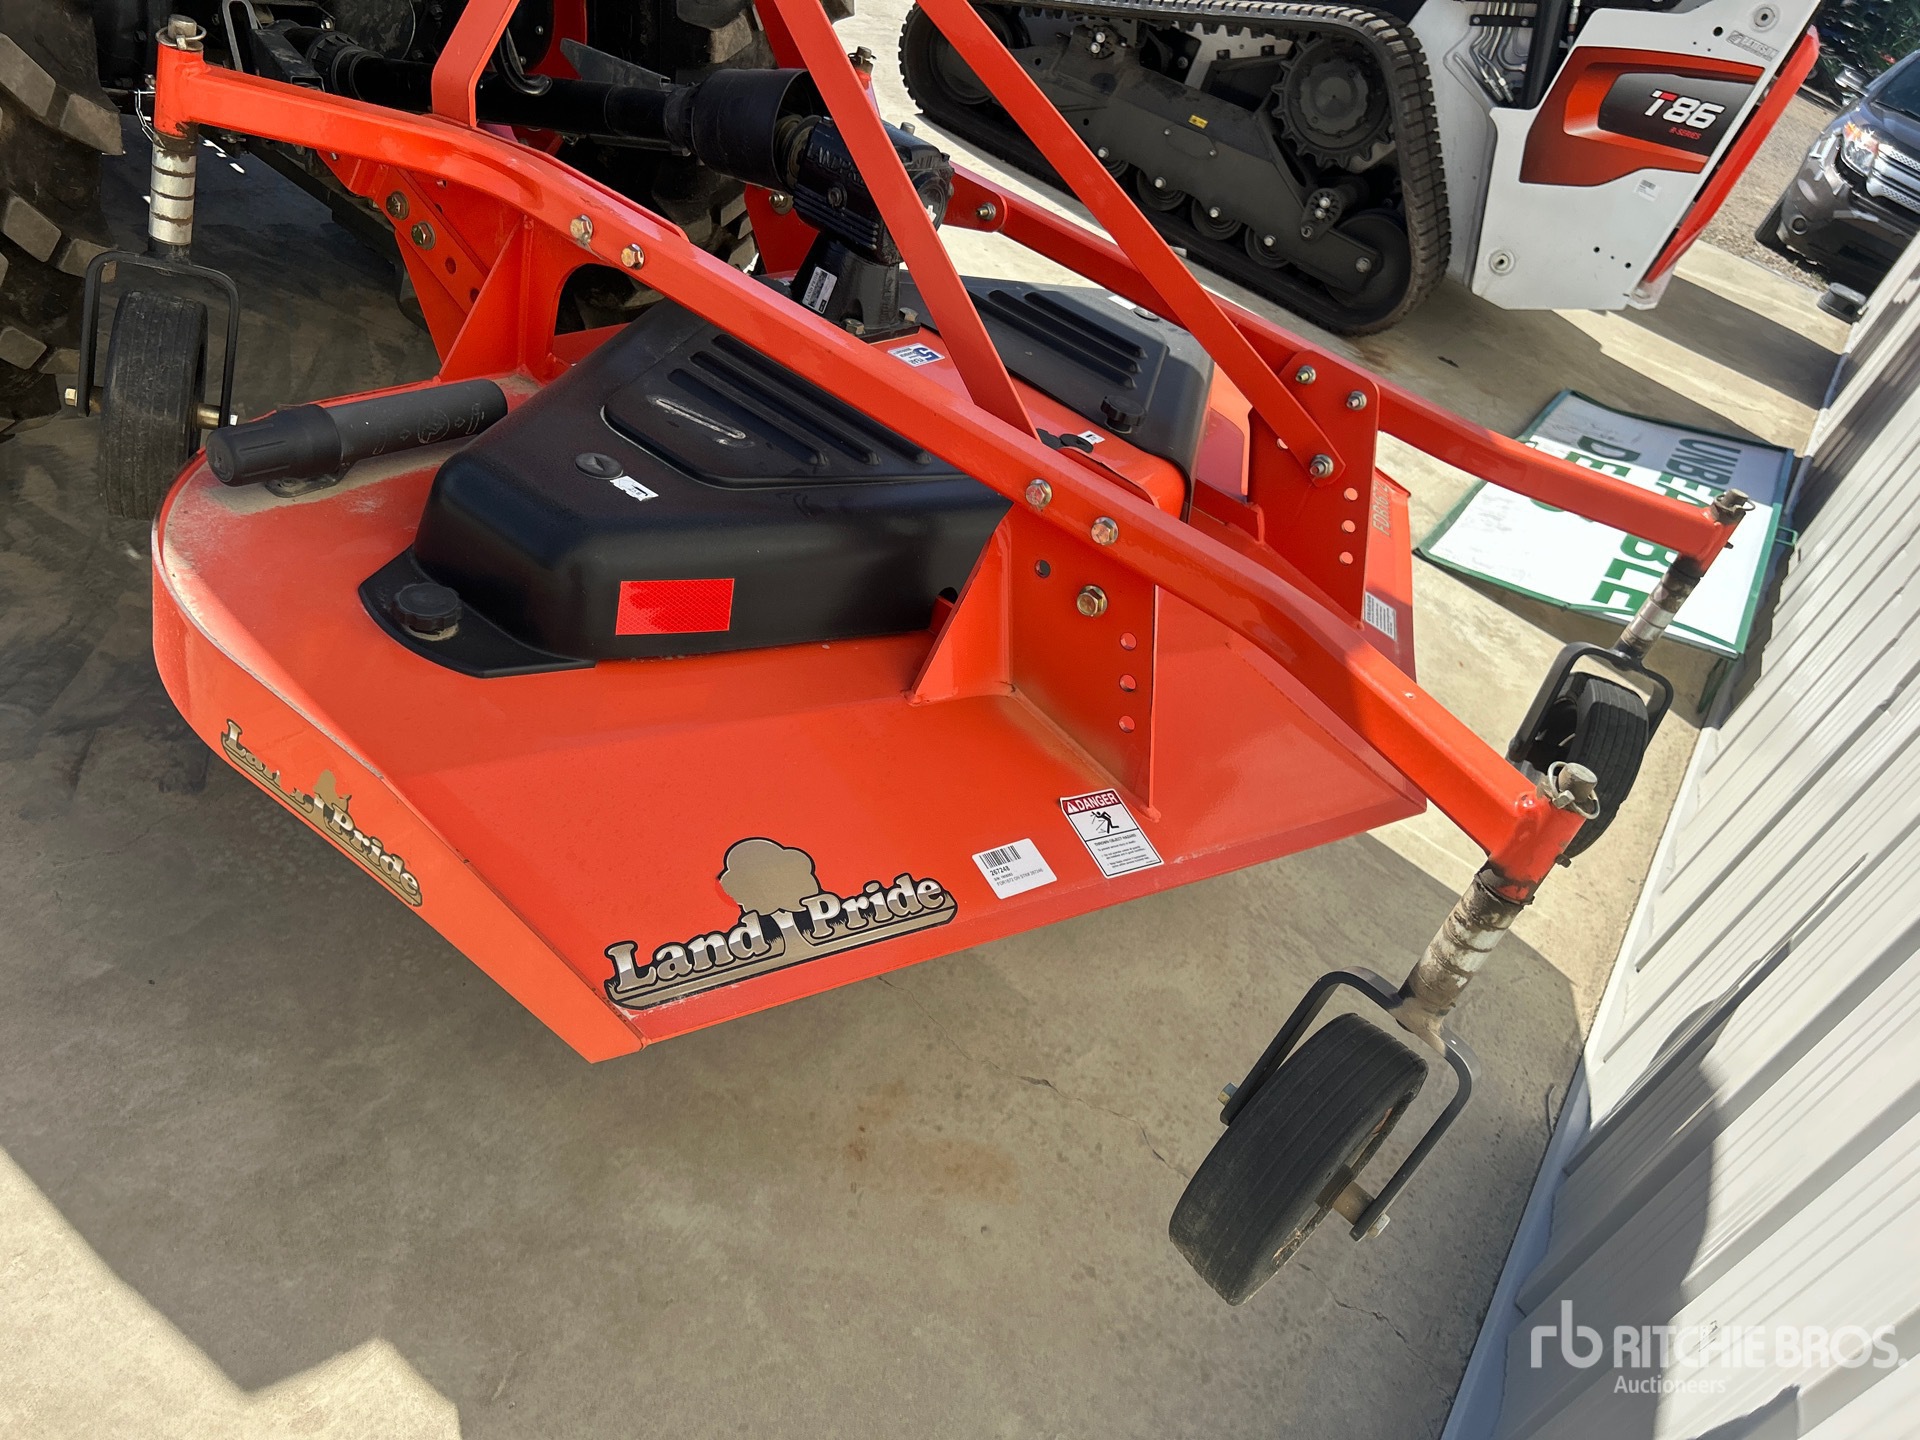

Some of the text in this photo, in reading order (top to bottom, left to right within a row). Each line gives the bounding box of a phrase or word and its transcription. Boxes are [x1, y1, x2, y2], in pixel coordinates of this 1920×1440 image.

[1644, 90, 1726, 129] T86
[1076, 792, 1119, 810] DANGER
[327, 803, 418, 896] Pride
[989, 865, 1011, 876] 267248
[606, 872, 947, 993] Land Pride
